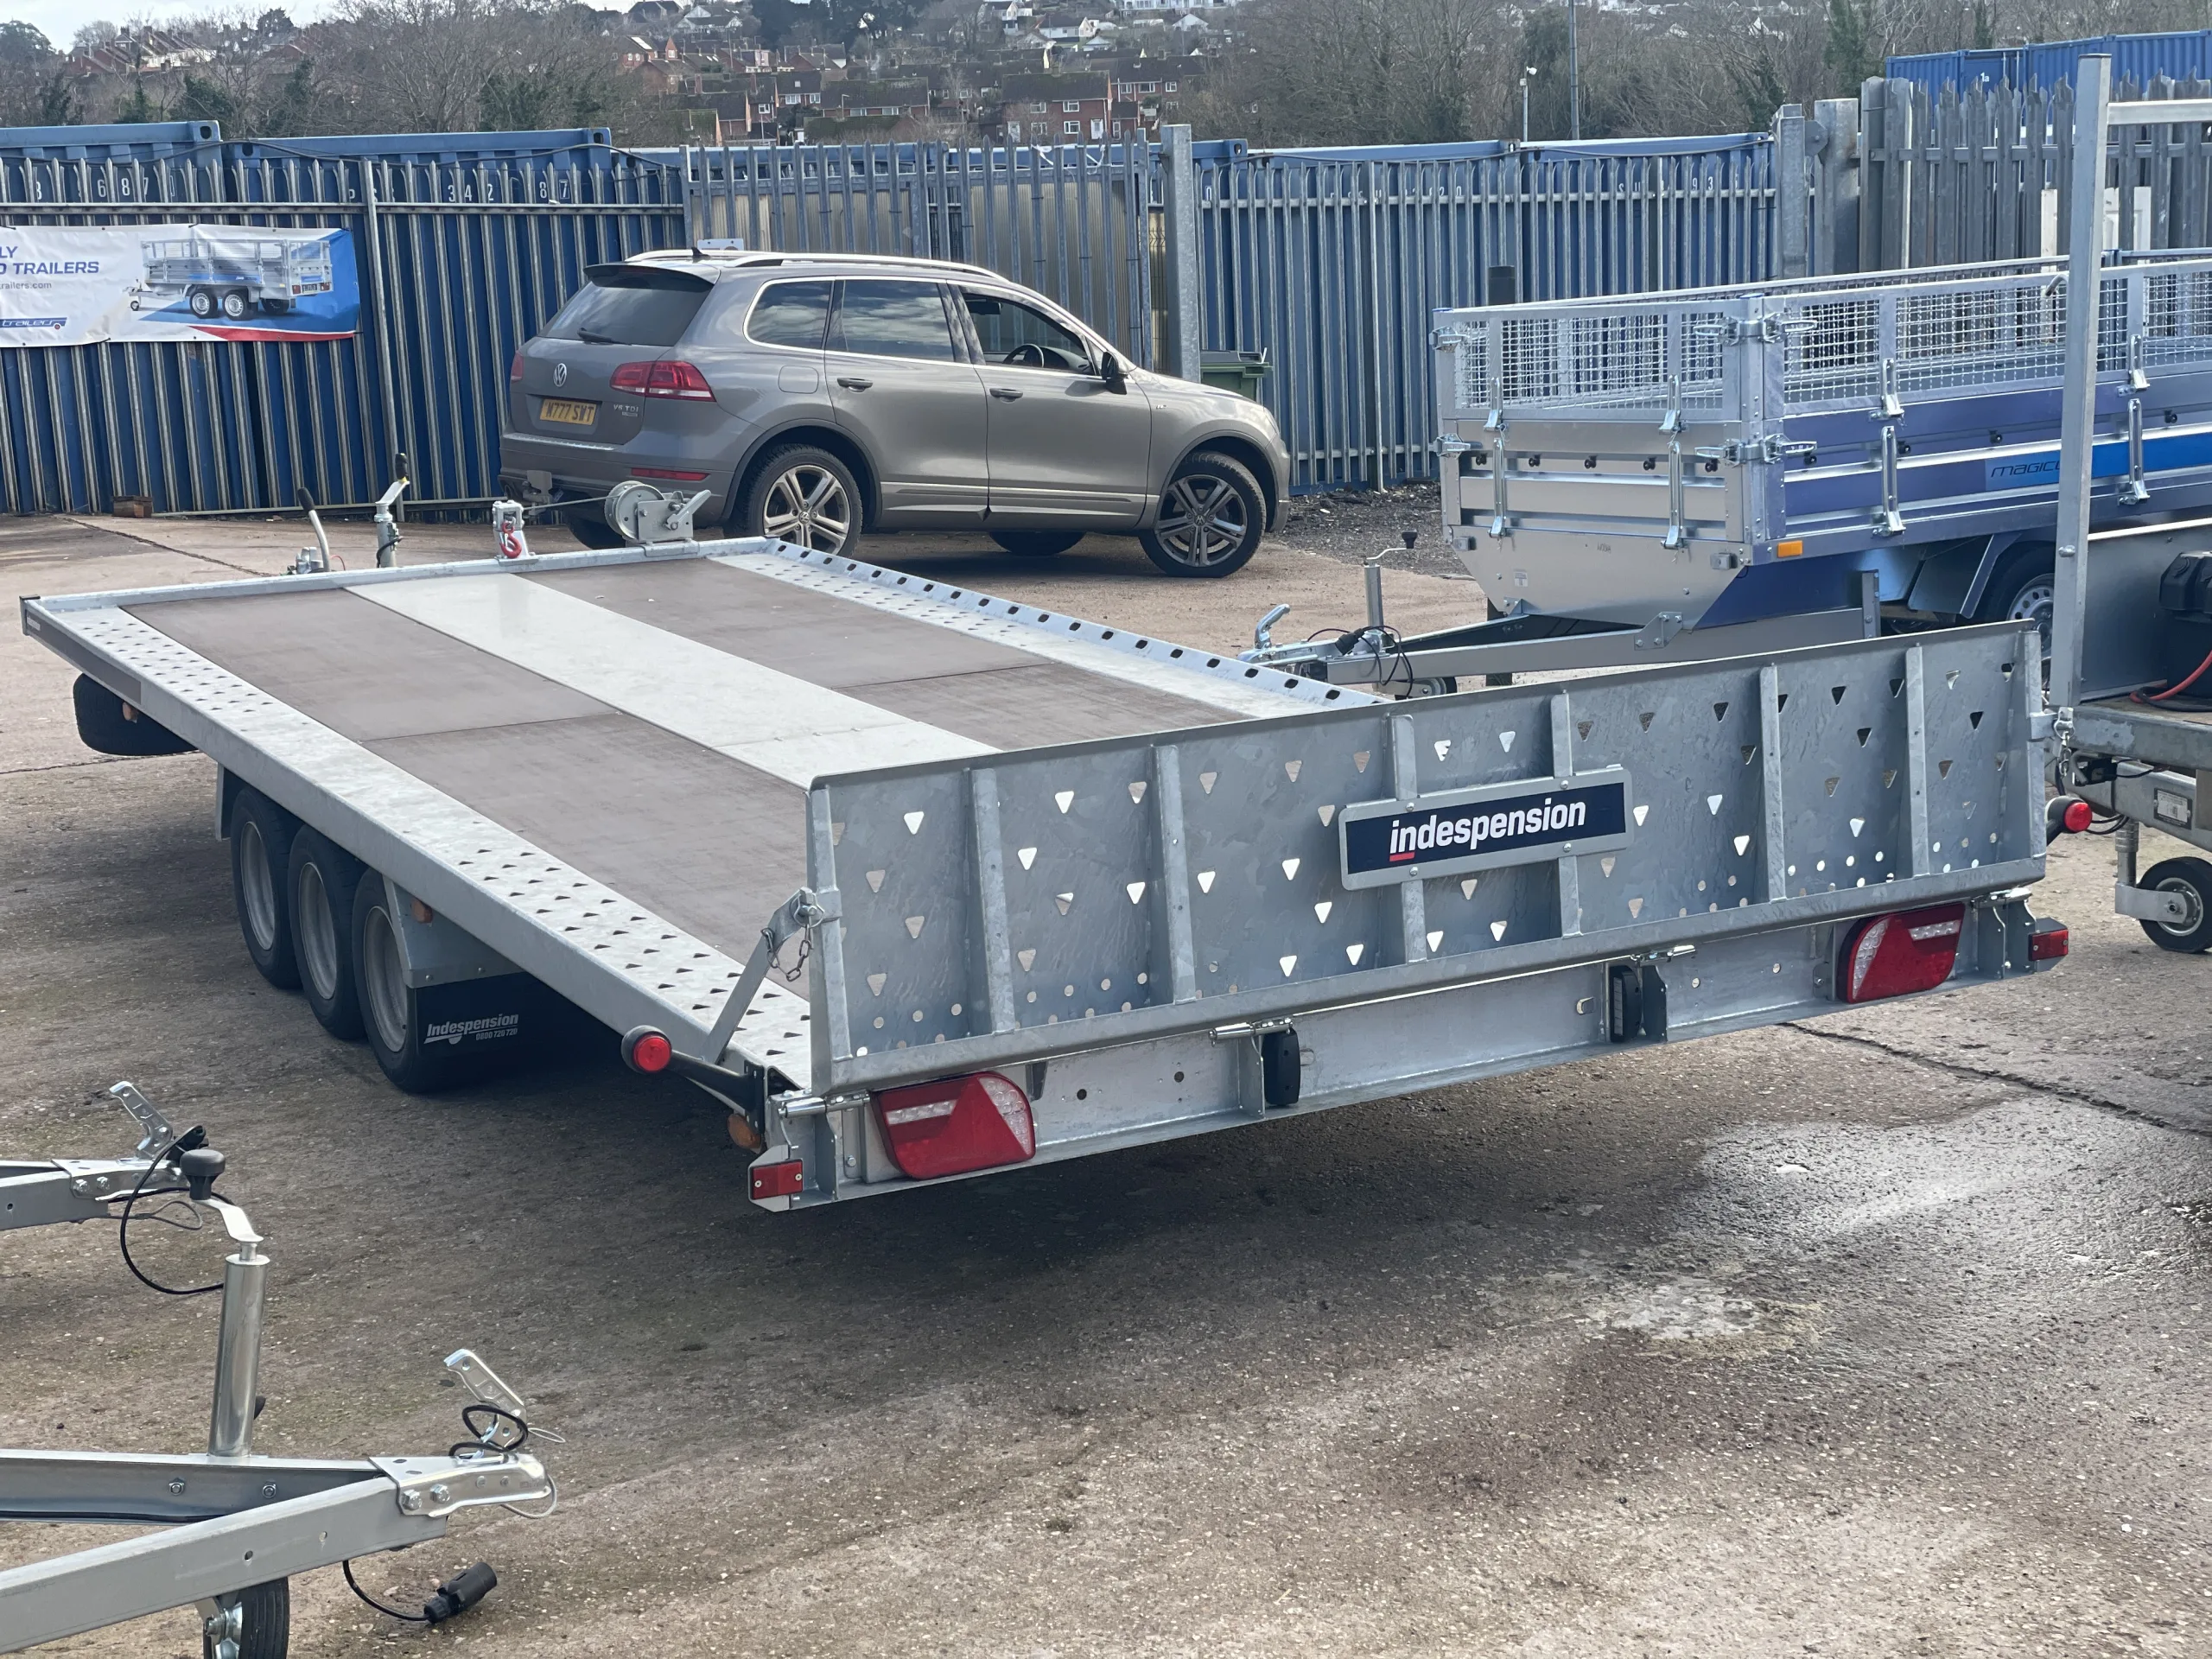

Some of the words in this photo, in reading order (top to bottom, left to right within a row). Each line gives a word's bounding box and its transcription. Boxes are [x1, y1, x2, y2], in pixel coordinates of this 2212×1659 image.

[1980, 72, 1990, 82] 1a
[13, 262, 99, 275] TRAILERS
[1390, 798, 1586, 853] indespension
[427, 1014, 518, 1035] Indespension
[476, 1032, 493, 1040] 0800
[493, 1029, 505, 1038] 720
[505, 1027, 518, 1036] 720
